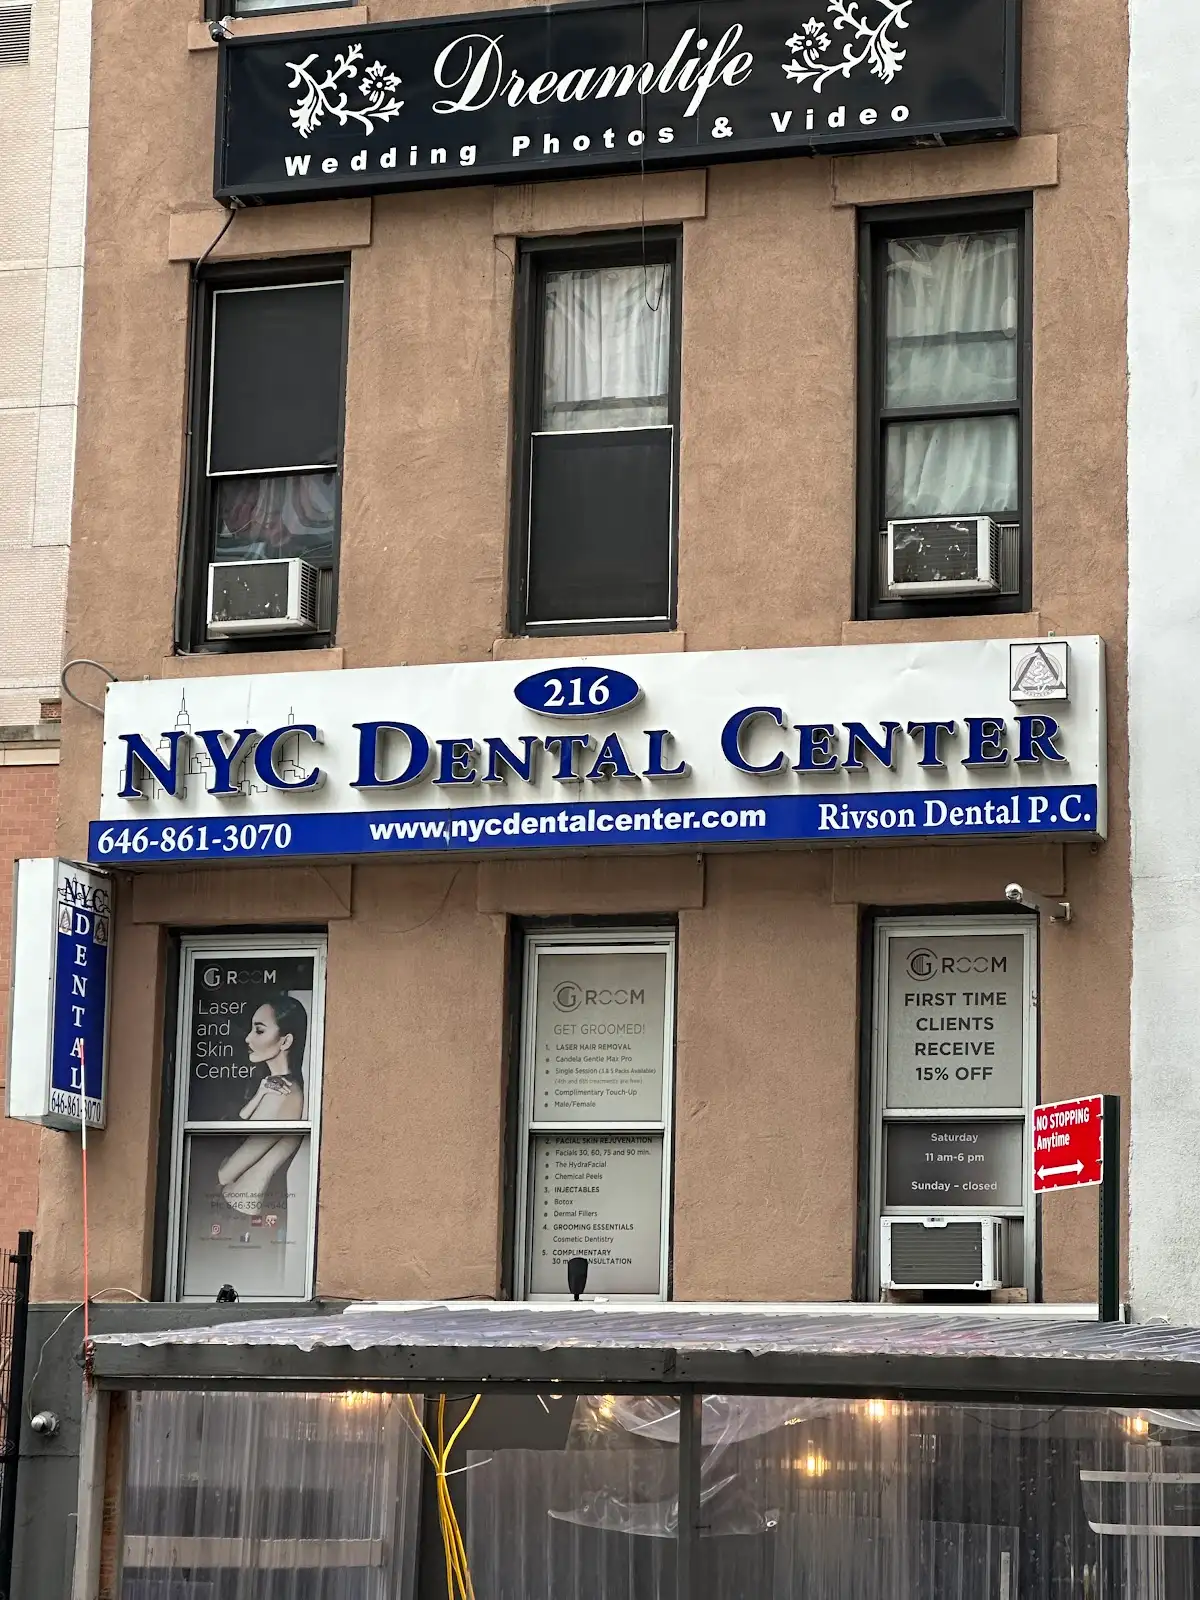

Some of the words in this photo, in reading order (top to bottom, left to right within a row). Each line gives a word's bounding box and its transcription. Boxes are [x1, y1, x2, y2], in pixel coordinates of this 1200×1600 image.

[432, 23, 753, 119] Dreamlife
[285, 143, 477, 177] Wedding
[512, 125, 674, 157] Photos
[711, 117, 733, 139] &
[769, 103, 911, 133] Video
[543, 675, 610, 707] 216
[117, 724, 322, 799] NYC
[350, 721, 688, 790] DENTAL
[721, 706, 1068, 776] CENTER
[97, 823, 292, 854] 646-861-3070
[369, 807, 767, 841] www.nycdentalcenter.com
[818, 801, 916, 831] Rivson
[923, 797, 1021, 828] Dental
[1028, 794, 1092, 824] P.C.
[64, 877, 106, 913] NYC
[911, 953, 1007, 975] GROOM
[70, 913, 91, 1089] DENTAL
[557, 986, 645, 1007] GROOM
[904, 993, 956, 1006] FIRST
[963, 992, 1007, 1006] TIME
[198, 1000, 247, 1015] Laser
[196, 1020, 231, 1036] and
[554, 1024, 577, 1035] GET
[580, 1023, 646, 1035] GROOMED!
[916, 1017, 994, 1031] CLIENTS
[196, 1041, 233, 1058] Skin
[915, 1042, 995, 1055] RECEIVE
[195, 1063, 256, 1079] Center
[555, 1067, 574, 1075] Single
[915, 1067, 949, 1081] 15%
[955, 1067, 993, 1080] OFF
[554, 1100, 596, 1108] Male/Female
[1036, 1115, 1048, 1131] NO
[1049, 1107, 1090, 1129] STOPPING
[931, 1133, 979, 1143] Saturday
[1036, 1131, 1070, 1151] Anytime
[568, 1161, 607, 1169] HydraFacial
[925, 1153, 934, 1162] 11
[937, 1153, 964, 1162] am-6
[967, 1154, 985, 1164] pm
[911, 1181, 951, 1191] Sunday
[962, 1182, 998, 1190] closed
[584, 1236, 614, 1244] Dentistry
